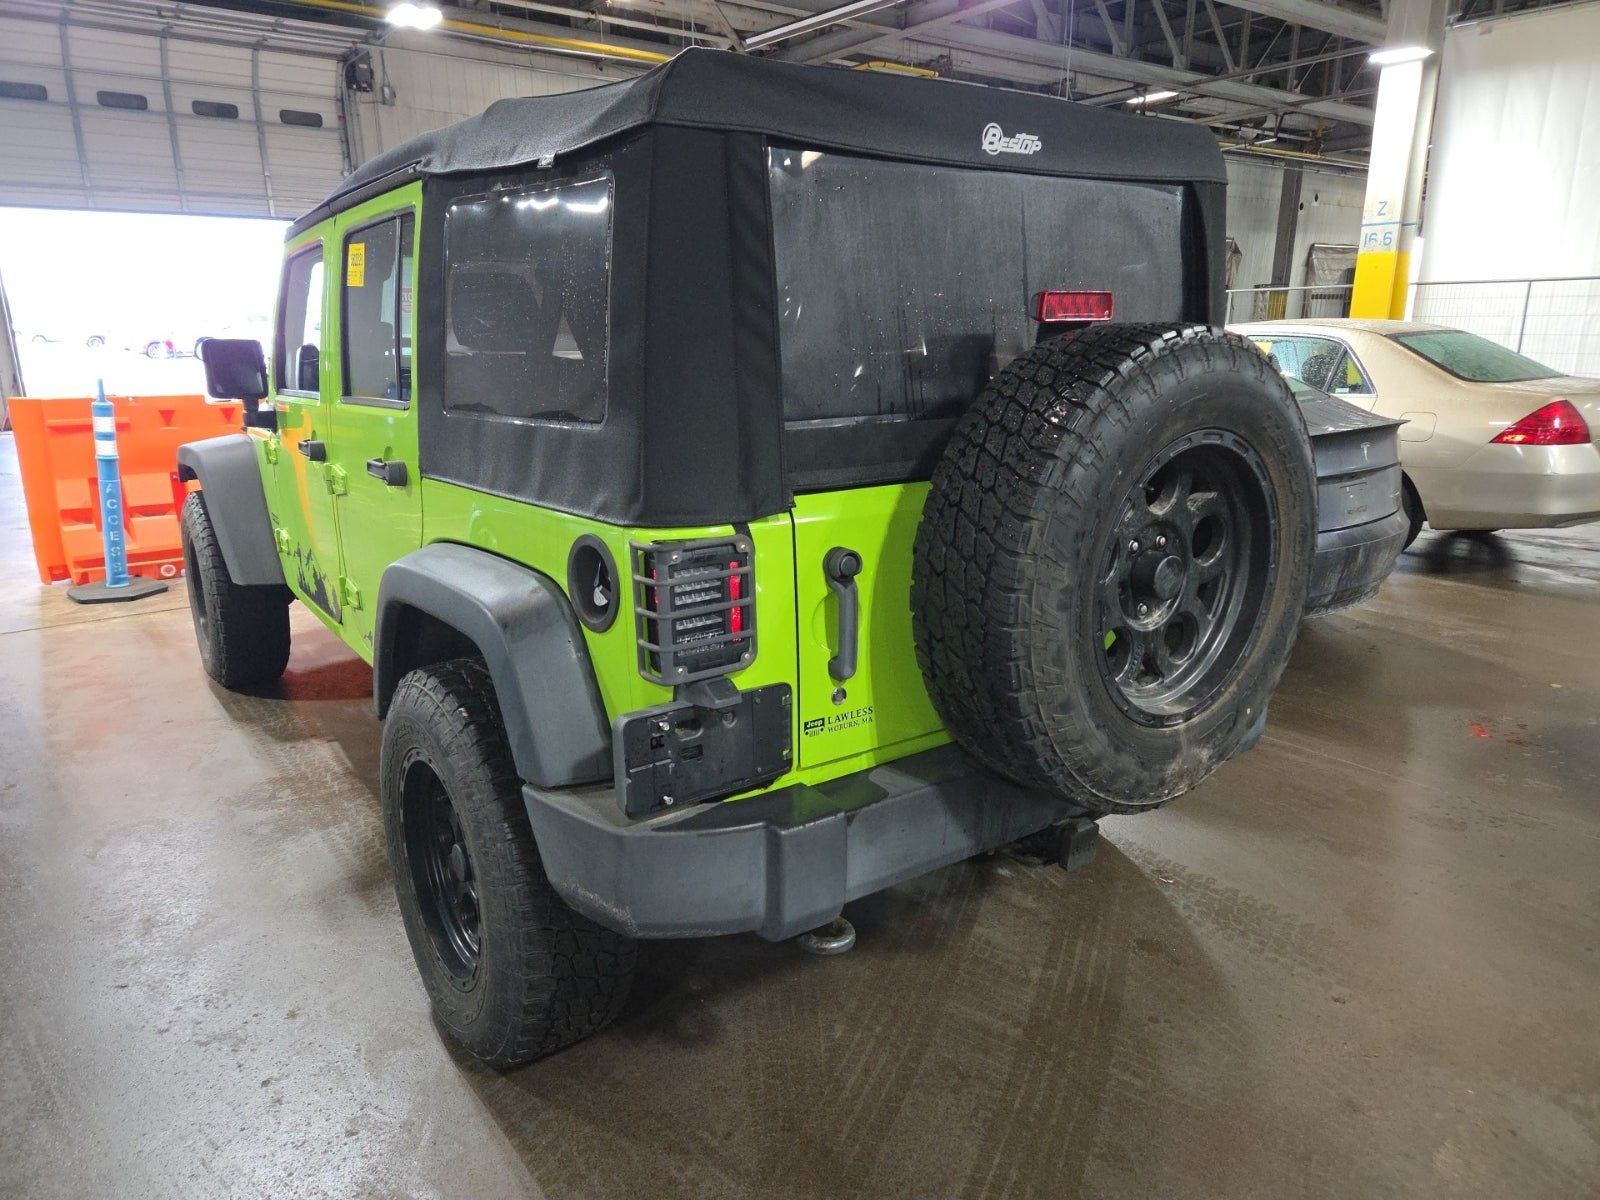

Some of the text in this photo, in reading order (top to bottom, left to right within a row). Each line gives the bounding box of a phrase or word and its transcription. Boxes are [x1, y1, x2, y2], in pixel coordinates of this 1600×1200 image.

[1377, 201, 1388, 216] Z
[106, 483, 122, 572] ACCESS
[828, 706, 873, 724] LAWLESS
[806, 720, 823, 728] Jeep
